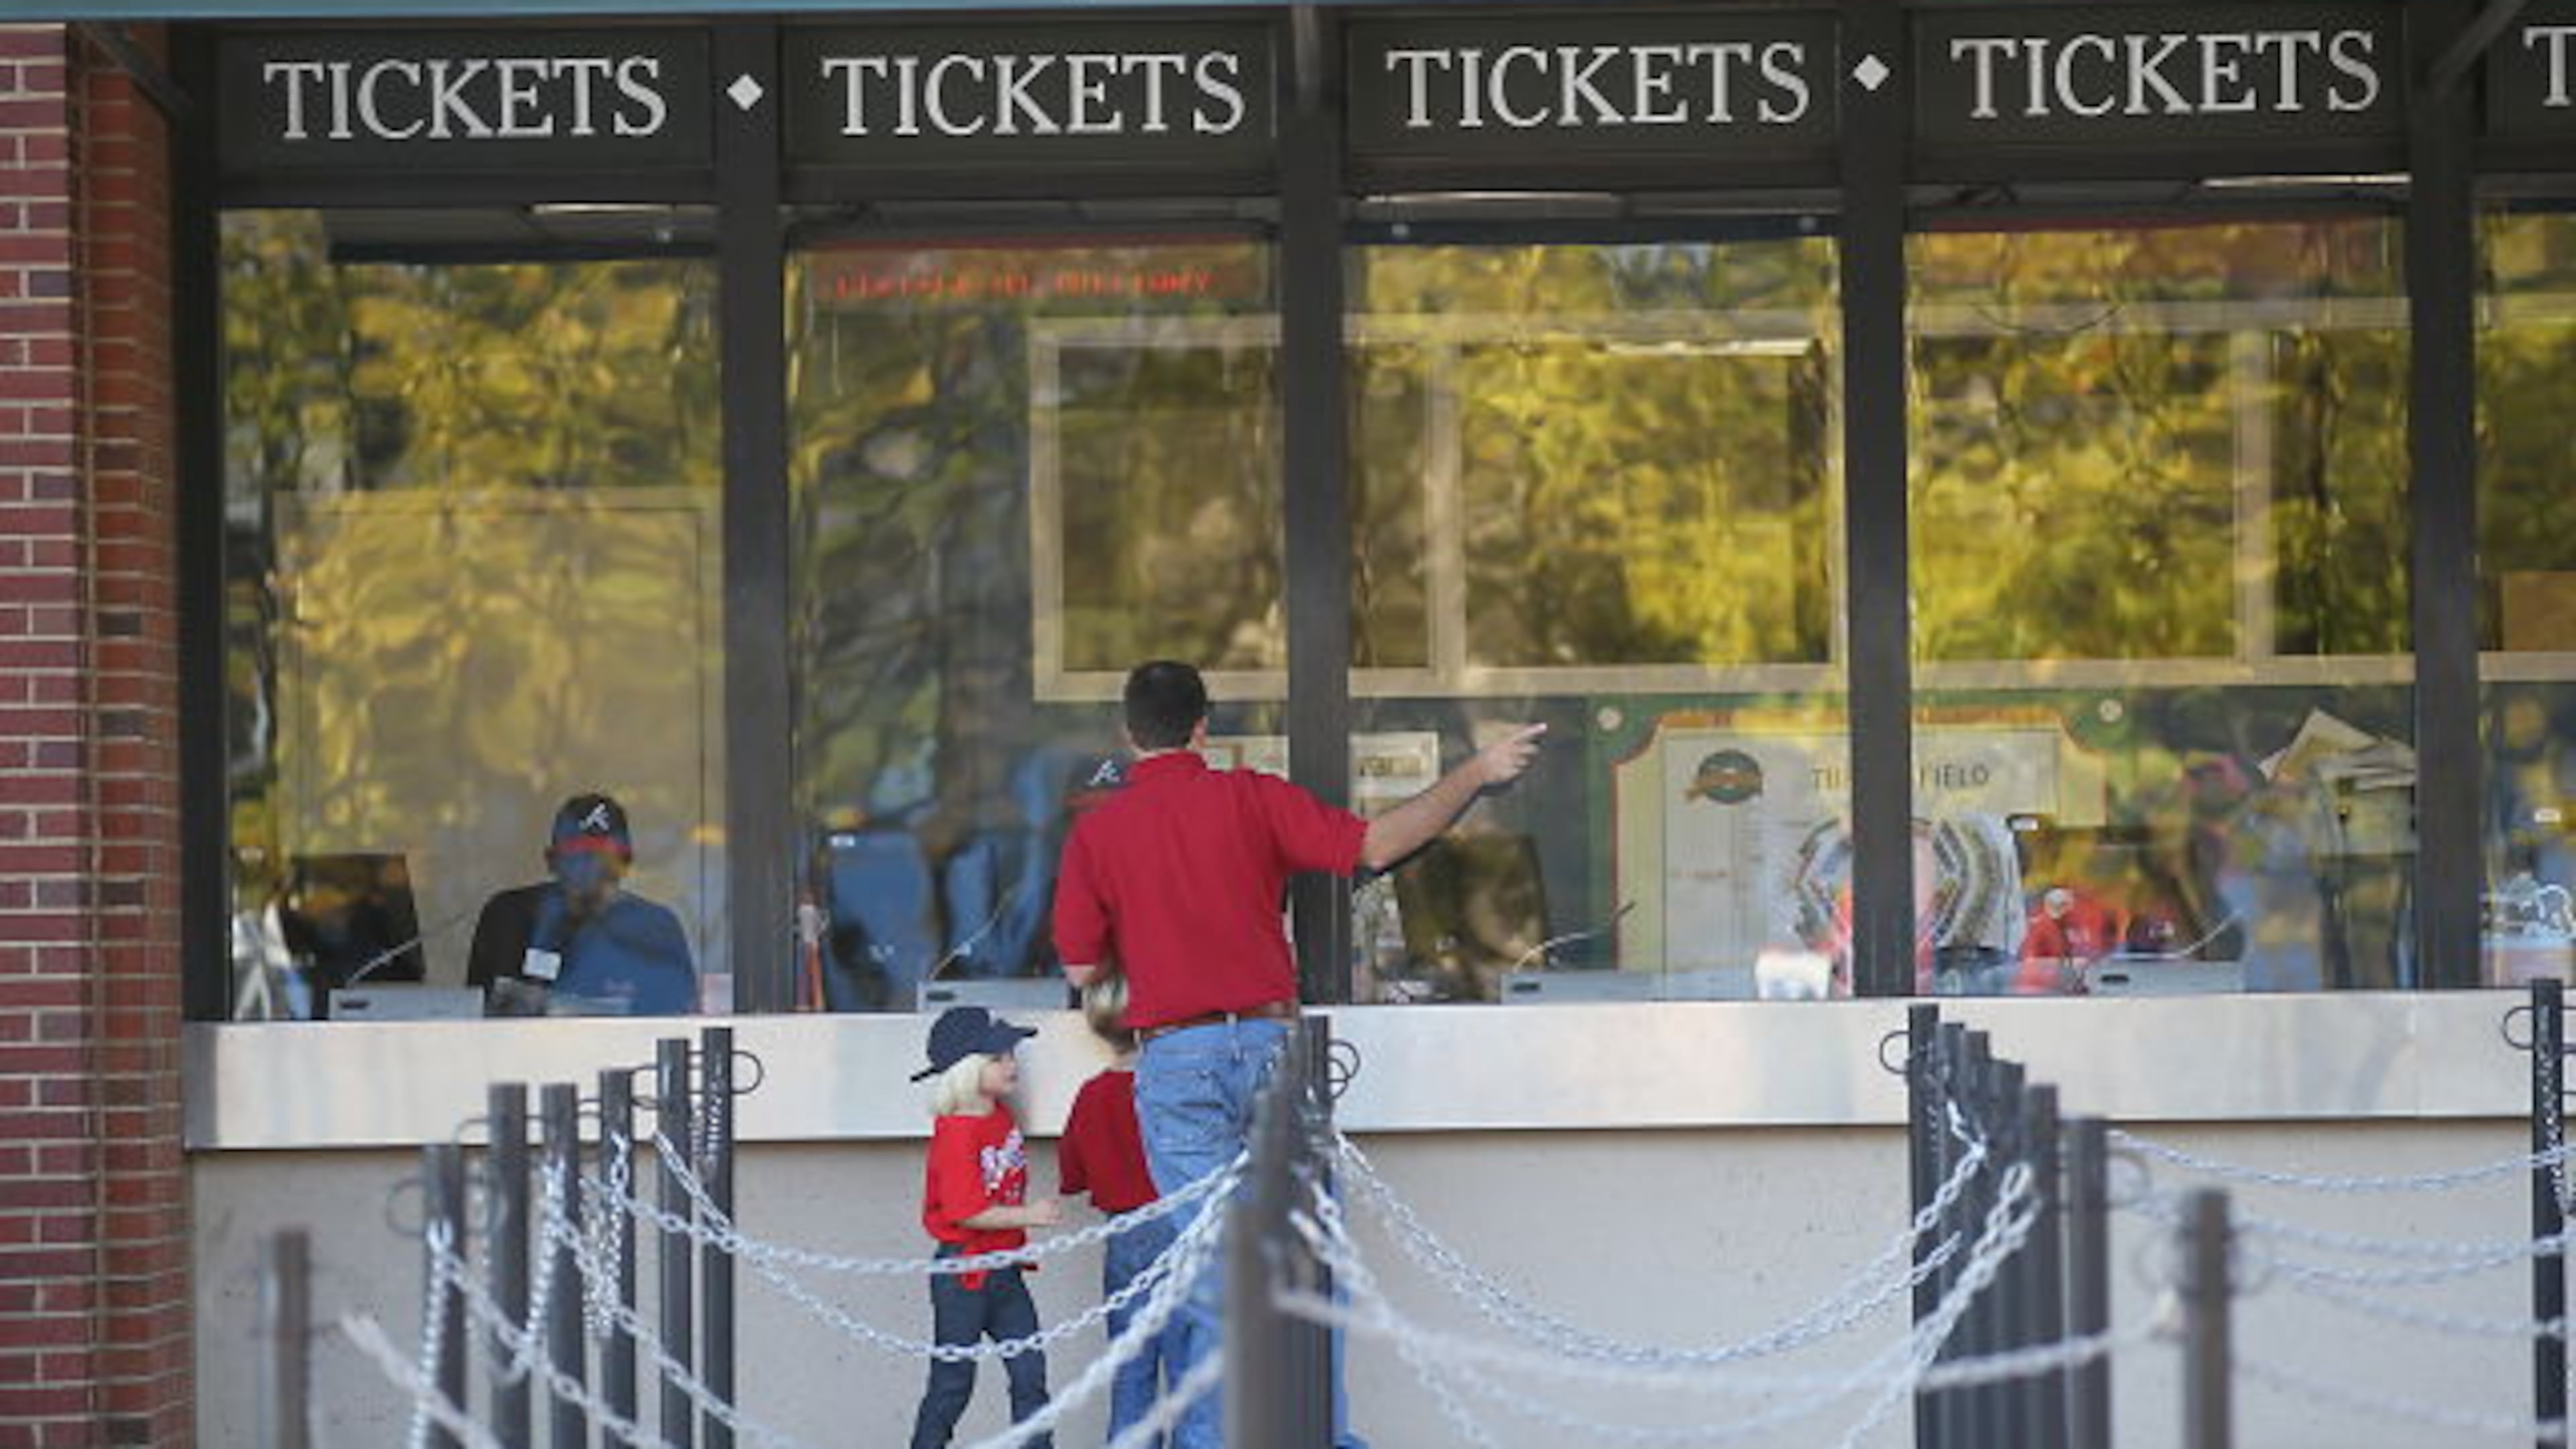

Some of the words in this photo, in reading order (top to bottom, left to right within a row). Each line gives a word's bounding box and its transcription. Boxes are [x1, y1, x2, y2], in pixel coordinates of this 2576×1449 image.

[264, 55, 666, 139] TICKETS
[822, 51, 1245, 136] TICKETS
[1386, 42, 1809, 127] TICKETS
[1951, 30, 2378, 118] TICKETS
